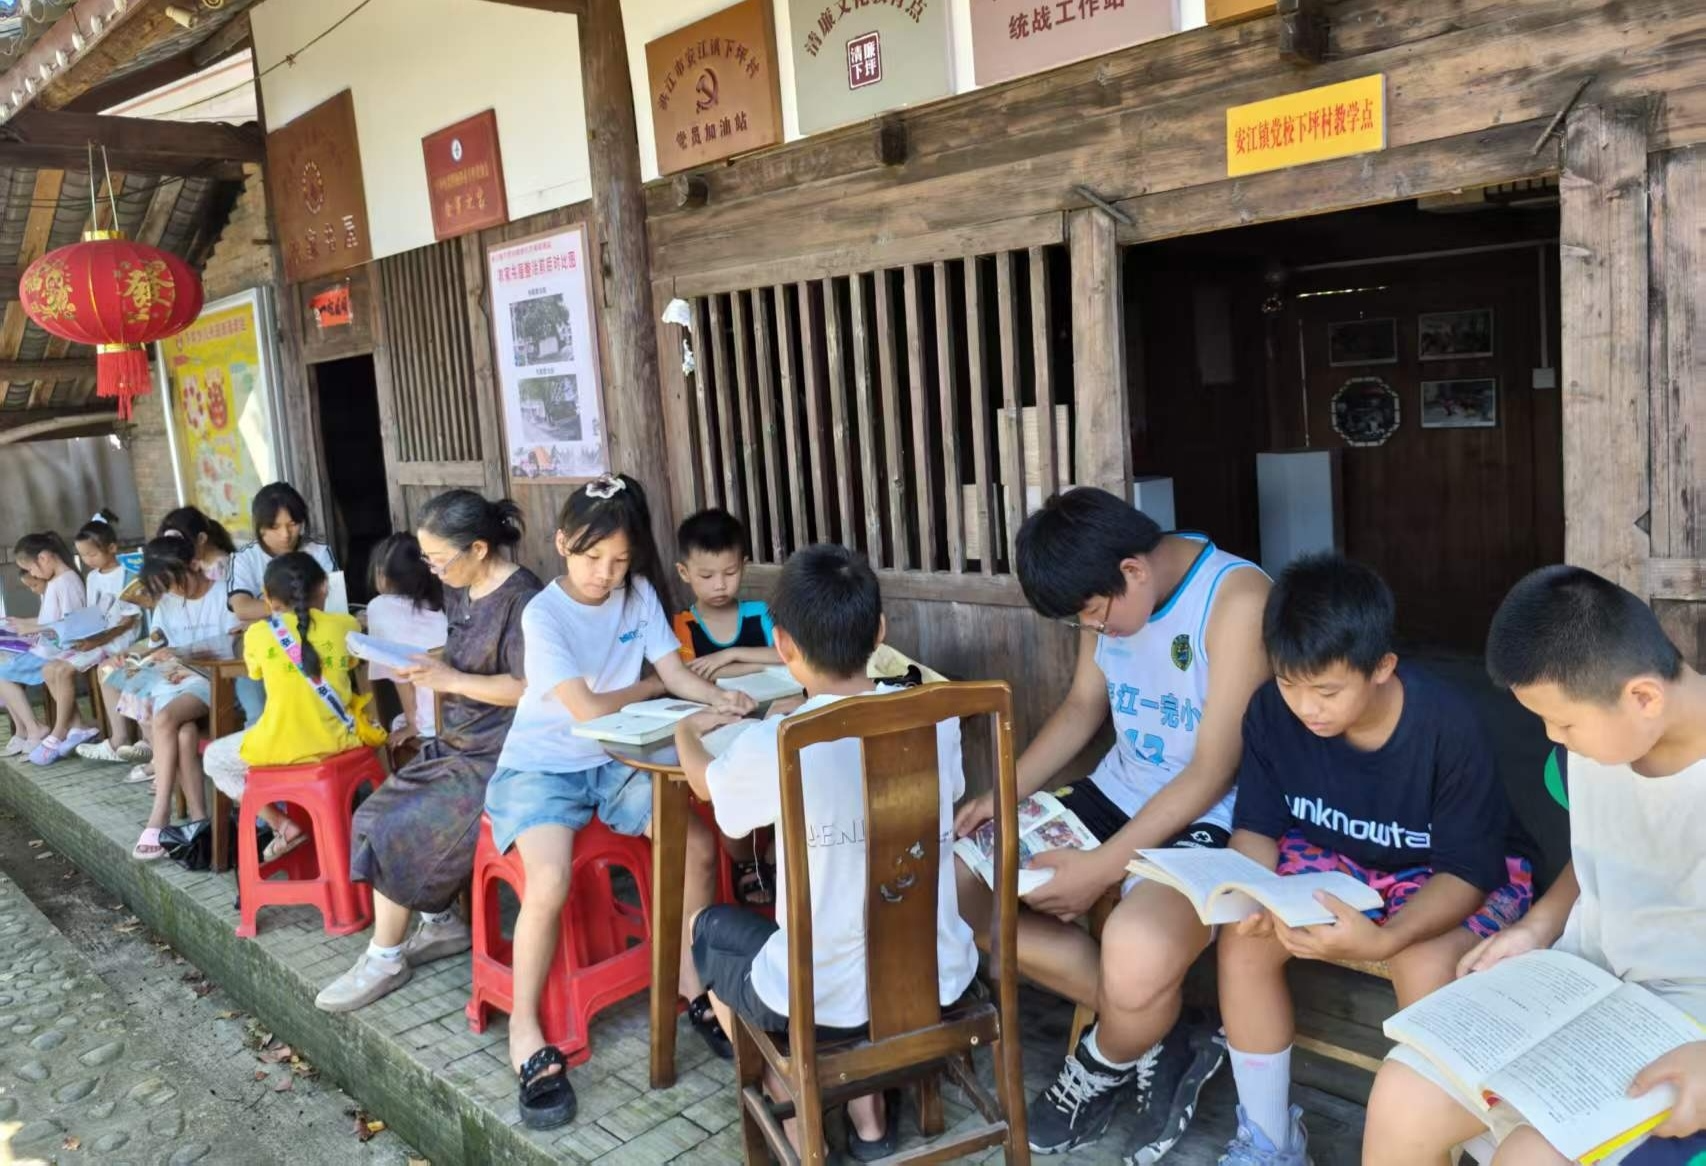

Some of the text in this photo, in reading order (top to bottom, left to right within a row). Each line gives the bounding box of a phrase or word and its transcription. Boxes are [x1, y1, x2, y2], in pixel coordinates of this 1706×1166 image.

[850, 41, 876, 63] 清廉
[851, 59, 877, 80] 下坪
[675, 110, 748, 150] 党员加油站
[1234, 98, 1374, 155] 安江镇党校下坪村教学点
[1284, 794, 1433, 849] unknowta
